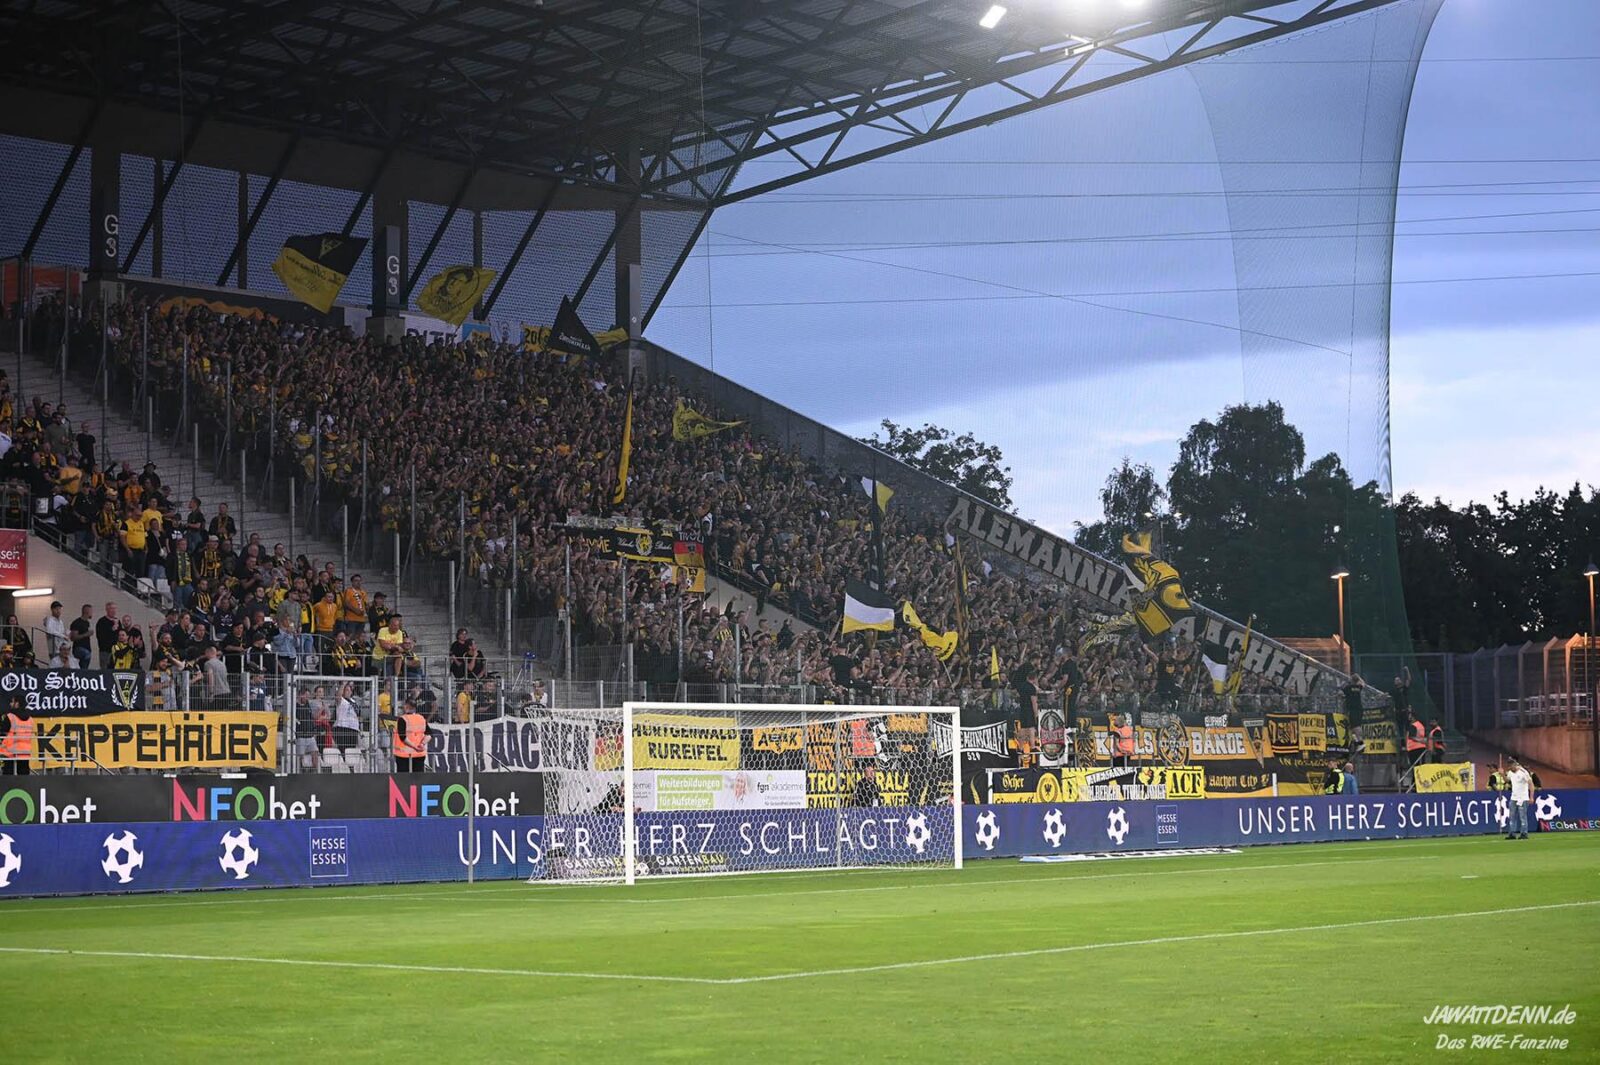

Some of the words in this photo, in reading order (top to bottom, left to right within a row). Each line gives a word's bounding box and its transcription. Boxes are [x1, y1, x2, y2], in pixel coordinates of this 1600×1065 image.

[104, 214, 119, 235] G
[105, 237, 117, 258] 3
[387, 256, 400, 275] G
[388, 277, 398, 296] 3
[1, 672, 38, 692] Old
[45, 671, 107, 692] School
[25, 691, 88, 712] Aachen
[37, 713, 268, 763] KAPPEHÄUER
[1191, 731, 1247, 755] BANDE
[1170, 772, 1202, 795] ACF
[1157, 814, 1177, 824] MESSE
[1238, 805, 1317, 836] UNSER
[1329, 803, 1386, 831] HERZ
[1397, 796, 1491, 829] SCHLÄGT
[1540, 820, 1578, 832] NEObet
[458, 828, 591, 867] UNSER
[740, 813, 900, 856] SCHLÄGT
[1157, 825, 1178, 834] ESSEN
[312, 837, 346, 850] MESSE
[312, 853, 346, 865] ESSEN
[656, 853, 725, 867] GARTENBAU
